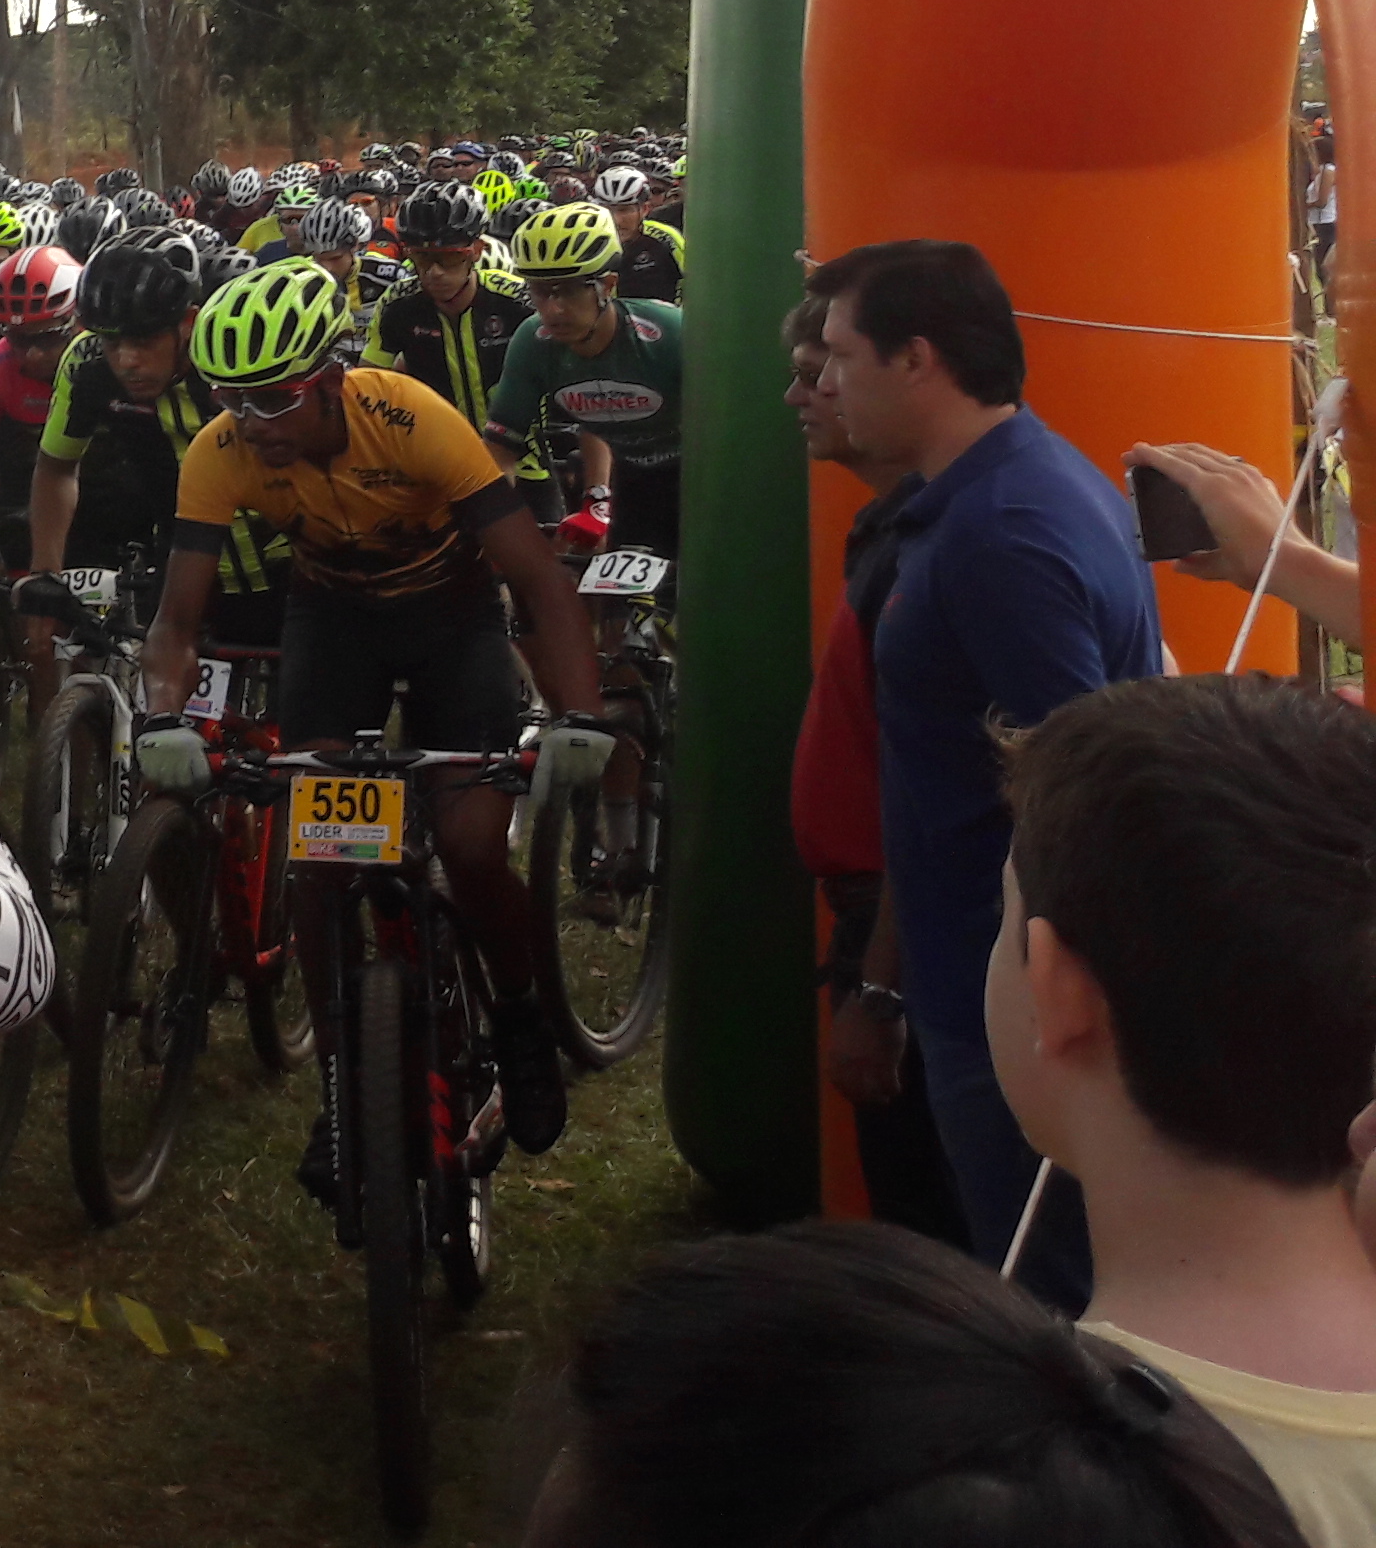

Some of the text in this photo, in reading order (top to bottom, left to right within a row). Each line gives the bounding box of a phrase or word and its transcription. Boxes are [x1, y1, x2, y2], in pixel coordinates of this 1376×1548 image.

[599, 553, 652, 583] 073
[311, 781, 382, 823] 550
[301, 824, 343, 839] LIDER
